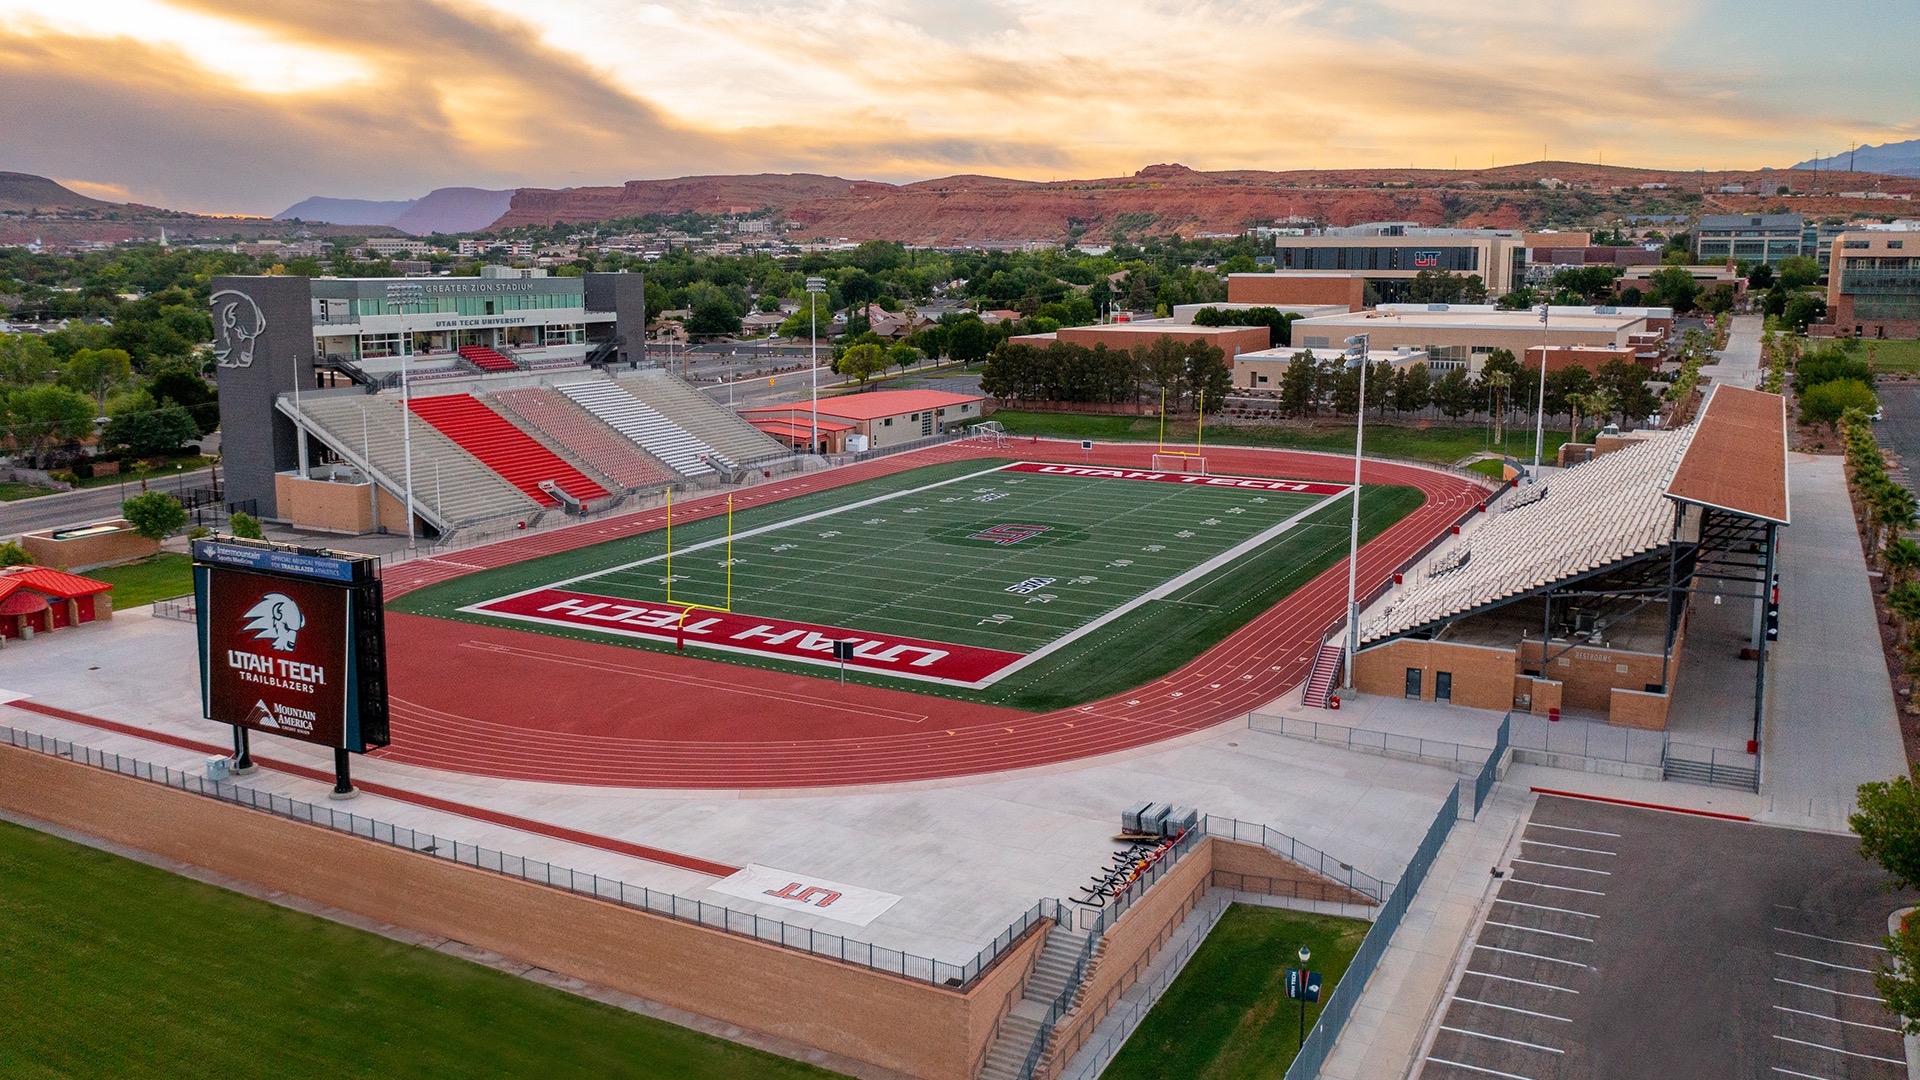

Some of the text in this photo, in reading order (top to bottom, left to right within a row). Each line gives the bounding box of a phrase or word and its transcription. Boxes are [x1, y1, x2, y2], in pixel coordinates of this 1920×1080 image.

[1414, 251, 1441, 267] UT
[425, 283, 533, 293] GREATER ZION STADIUM
[482, 317, 526, 325] UNIVERSITY
[1039, 467, 1309, 490] UTAH TECH
[216, 546, 261, 560] Intermountain
[217, 555, 254, 566] Sports Medicine
[271, 561, 340, 577] FOR TRAILBLAZER ATHLETICS
[293, 557, 313, 566] MEDICAL
[537, 599, 950, 667] UTAH TECH
[1575, 652, 1612, 662] RESTROOMS
[228, 650, 324, 684] UTAH TECH
[239, 671, 315, 693] TRAILBLAZERS
[274, 703, 316, 720] MOUNTAIN
[278, 714, 313, 730] AMERICA
[763, 882, 842, 907] UT
